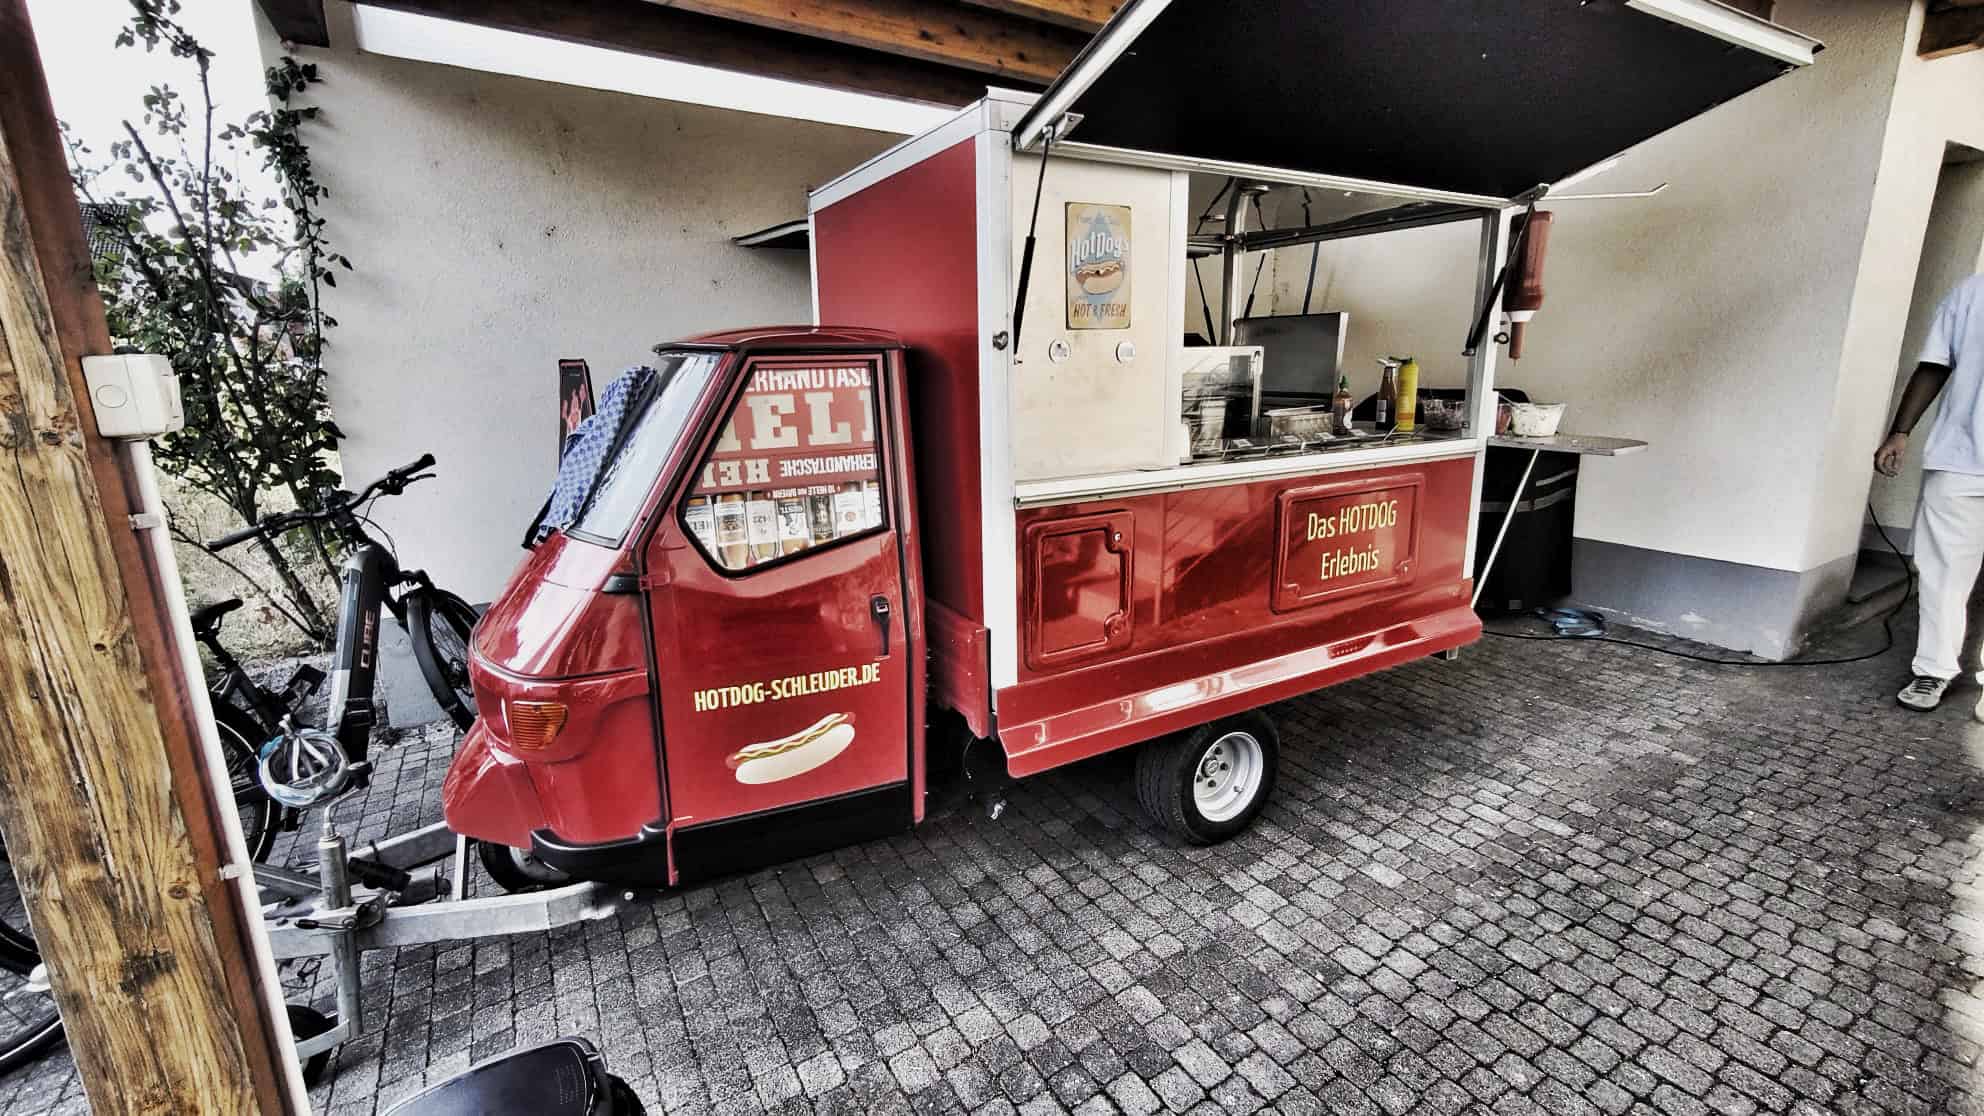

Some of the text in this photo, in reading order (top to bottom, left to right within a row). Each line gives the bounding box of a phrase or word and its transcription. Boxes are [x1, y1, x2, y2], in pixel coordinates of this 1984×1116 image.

[1073, 303, 1092, 318] HOT
[1101, 303, 1127, 319] FRESH
[1307, 500, 1398, 541] Das HOTDOG
[1320, 543, 1380, 580] Erlebnis
[694, 663, 881, 712] HOTDOG-SCHLEUDER.DE
